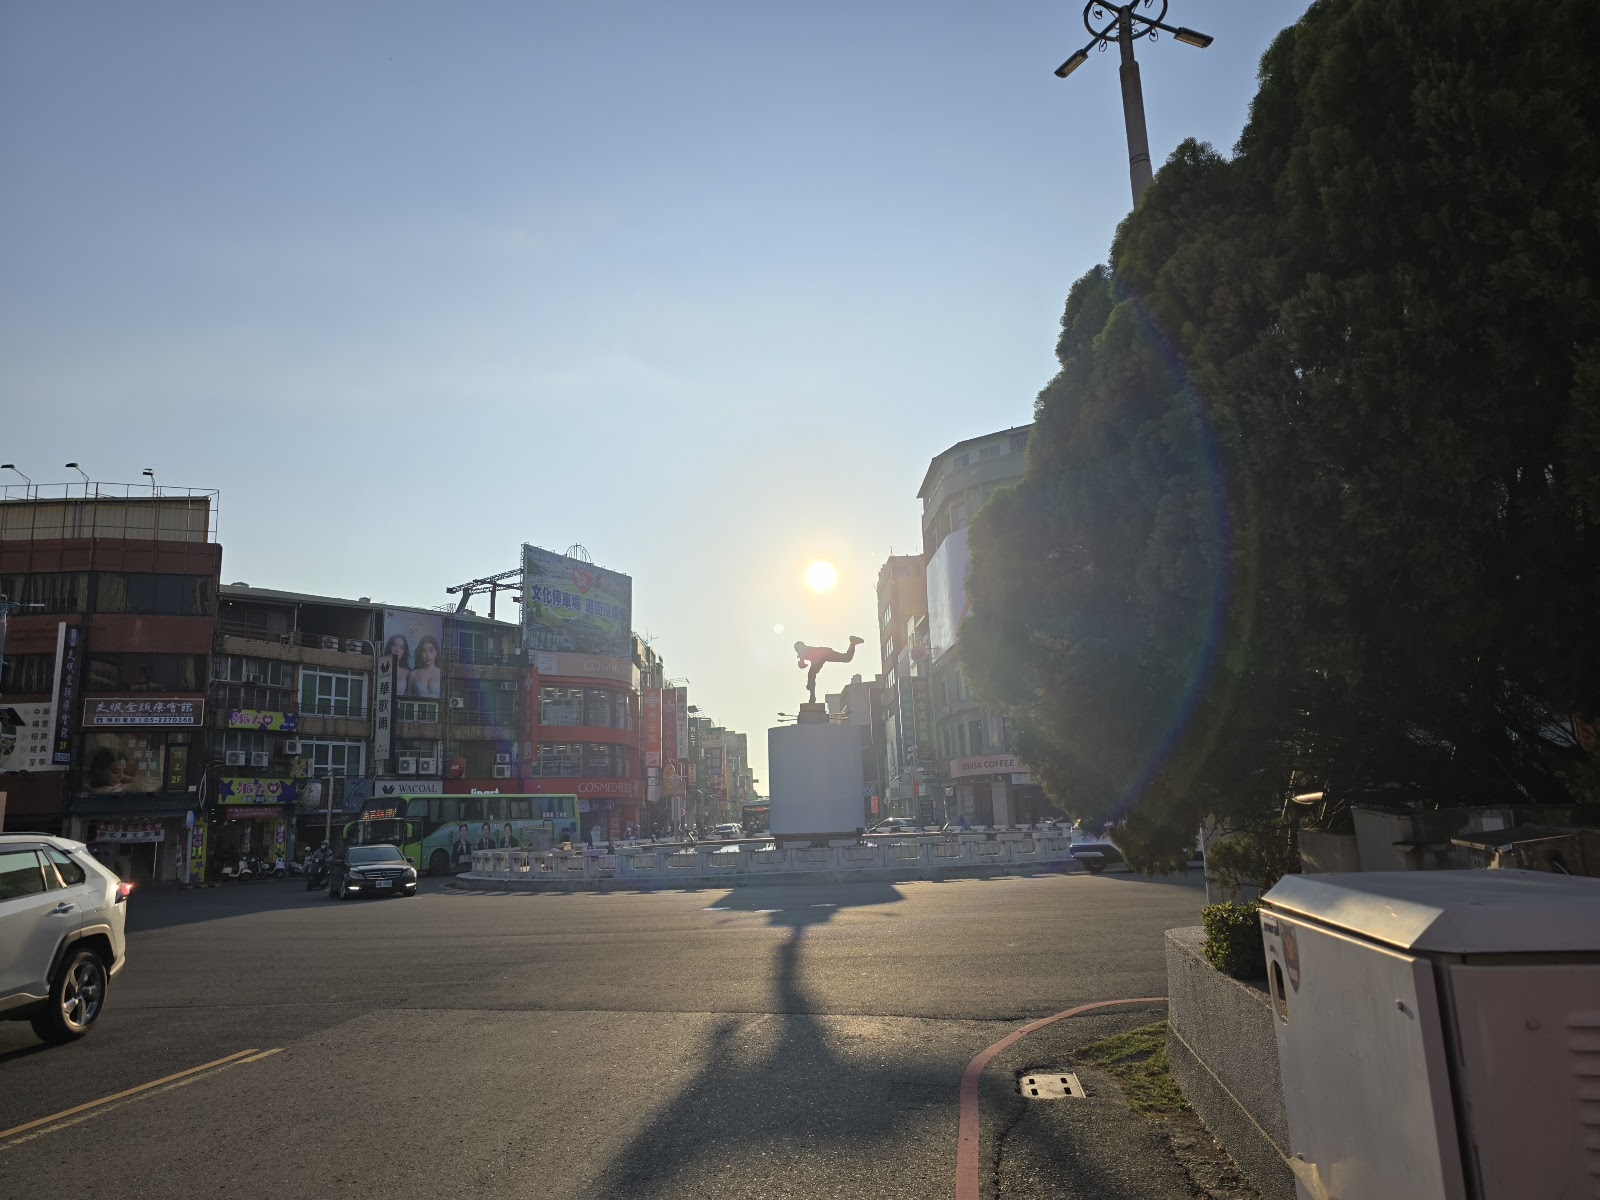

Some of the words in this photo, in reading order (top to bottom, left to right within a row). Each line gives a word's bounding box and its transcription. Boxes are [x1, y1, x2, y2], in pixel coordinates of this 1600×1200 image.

[531, 583, 581, 612] 文化停車場
[379, 681, 390, 730] 華歌爾
[31, 732, 48, 741] 招牌
[59, 741, 68, 750] 2F
[647, 752, 658, 760] 3F
[961, 762, 983, 771] LOUISA
[984, 759, 1015, 769] COFFEE
[398, 784, 438, 793] WACOAL
[578, 782, 618, 793] COSMED
